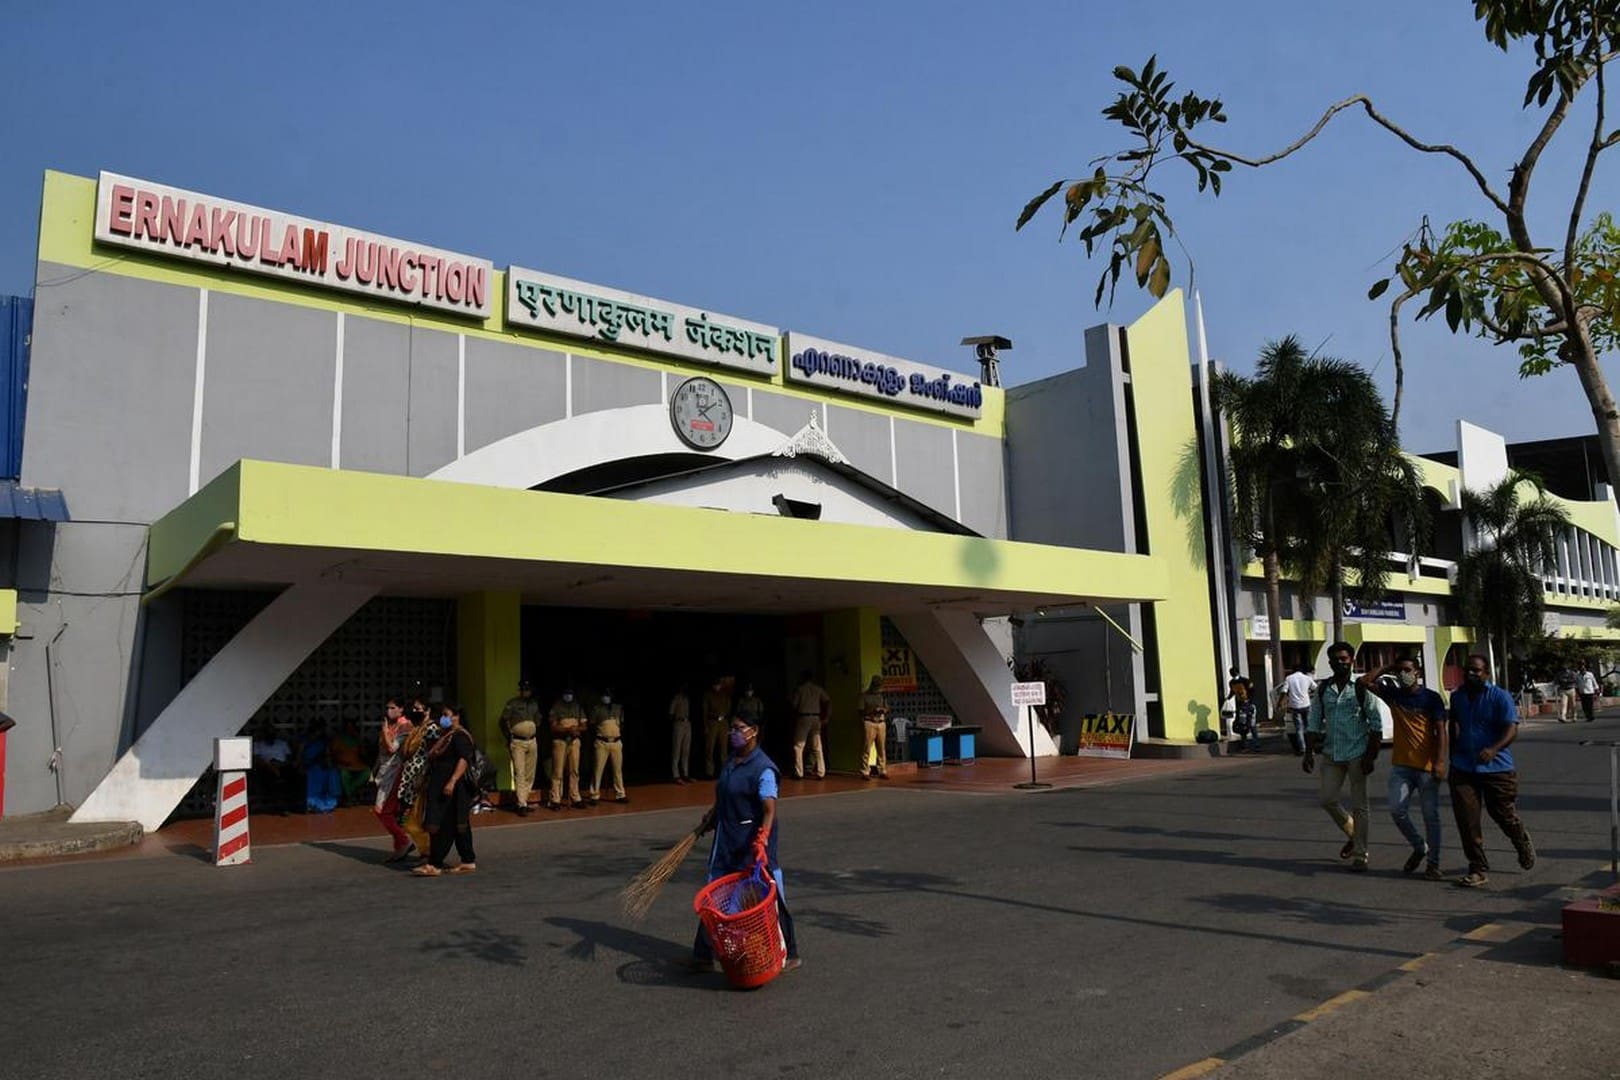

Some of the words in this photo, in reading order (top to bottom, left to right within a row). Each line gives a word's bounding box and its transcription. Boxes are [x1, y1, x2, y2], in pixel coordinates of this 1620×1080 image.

[109, 184, 329, 275] ERNAKULAM
[335, 237, 487, 306] JUNCTION
[516, 279, 675, 342] एरणाकुलम
[792, 347, 906, 397] എറണാകുളം
[1084, 713, 1133, 735] TAXI
